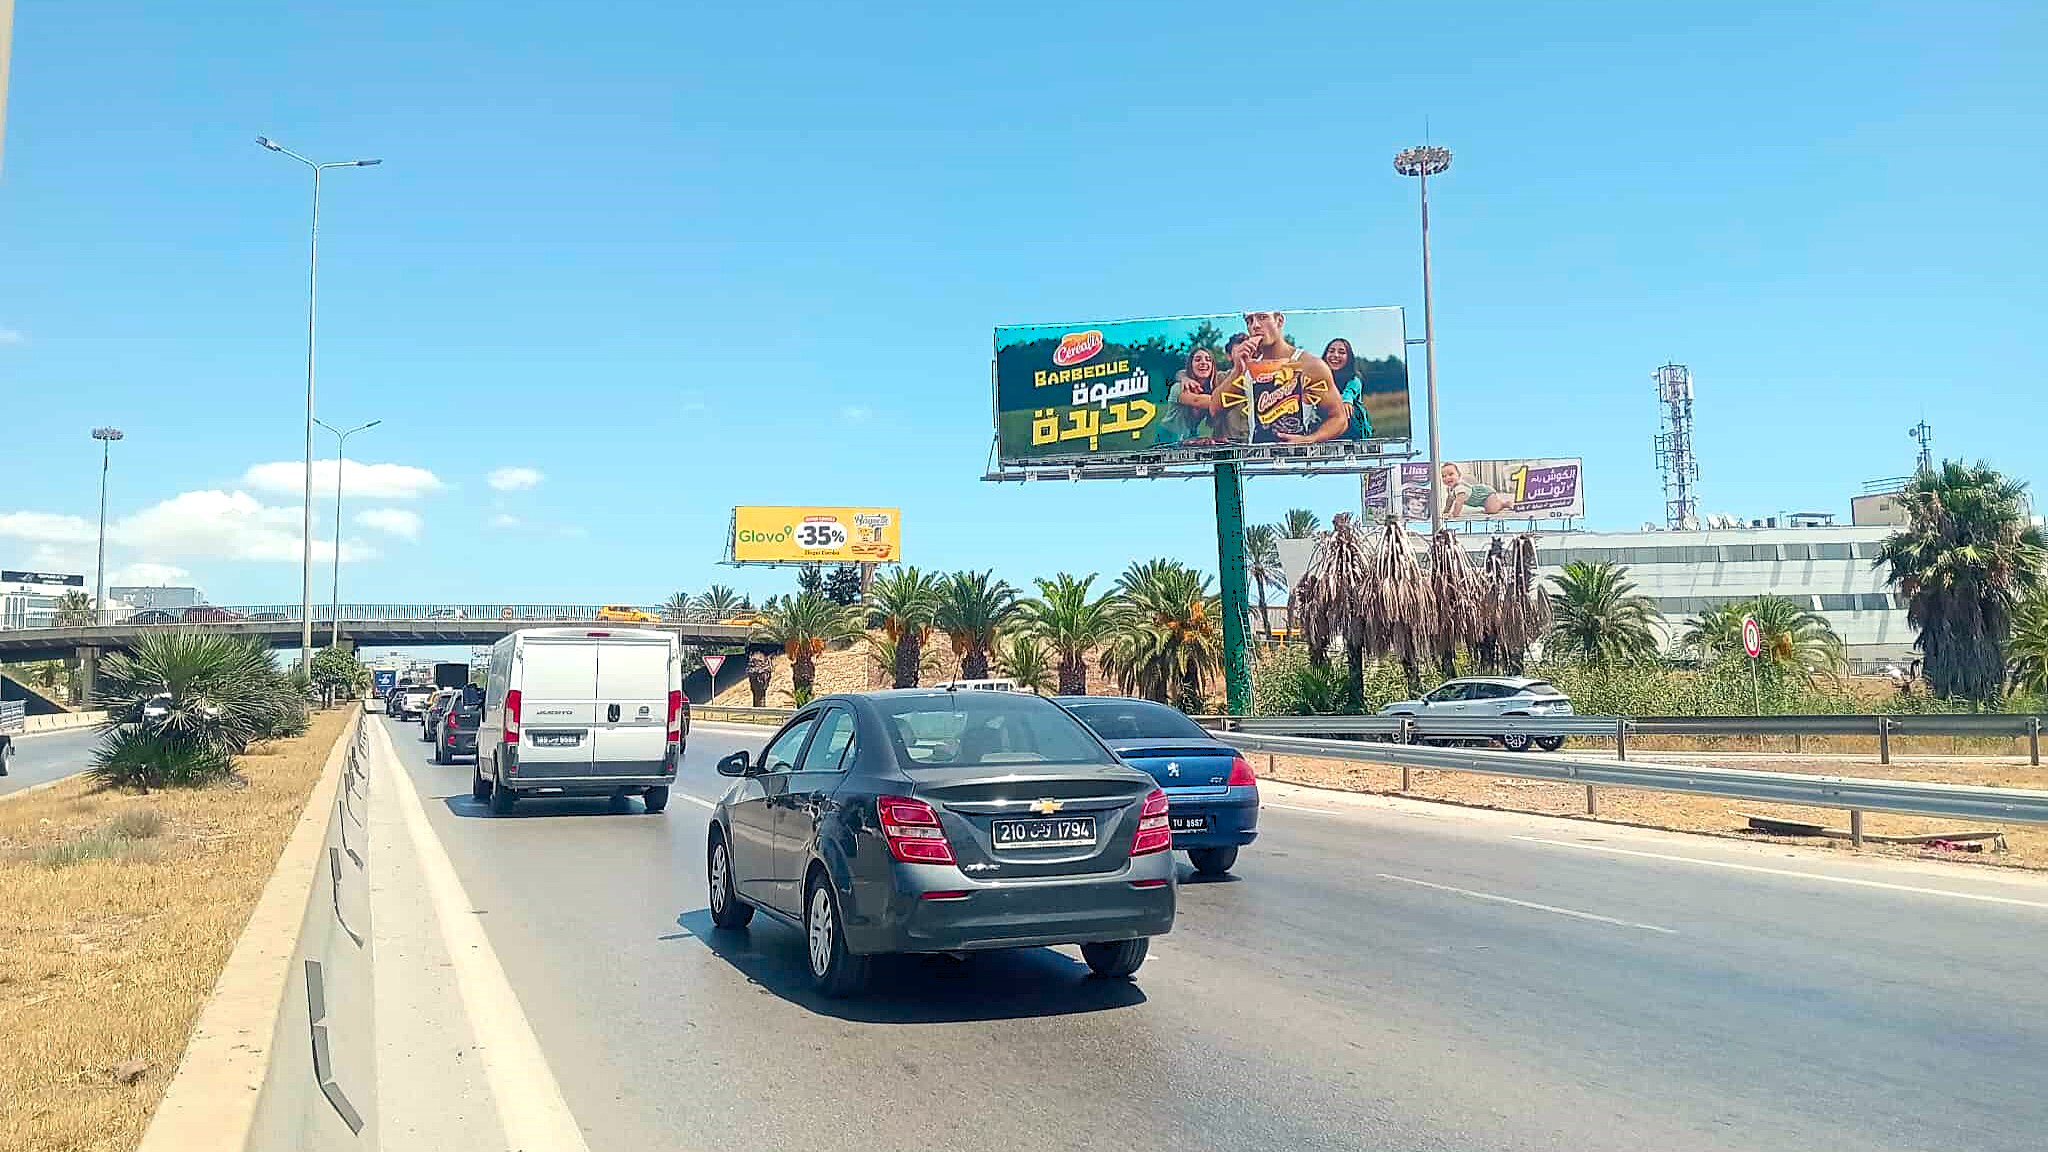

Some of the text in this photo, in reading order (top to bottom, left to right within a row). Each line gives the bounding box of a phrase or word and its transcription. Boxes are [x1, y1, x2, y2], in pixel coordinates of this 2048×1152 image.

[1034, 360, 1129, 387] BARBECUE
[1071, 366, 1149, 409] شهوة
[1031, 399, 1156, 451] جديدة
[1511, 466, 1528, 502] 1
[1527, 482, 1566, 499] تونس
[739, 530, 785, 542] Glovo
[798, 526, 844, 545] -35%
[1001, 822, 1090, 841] 210 تونس 1794
